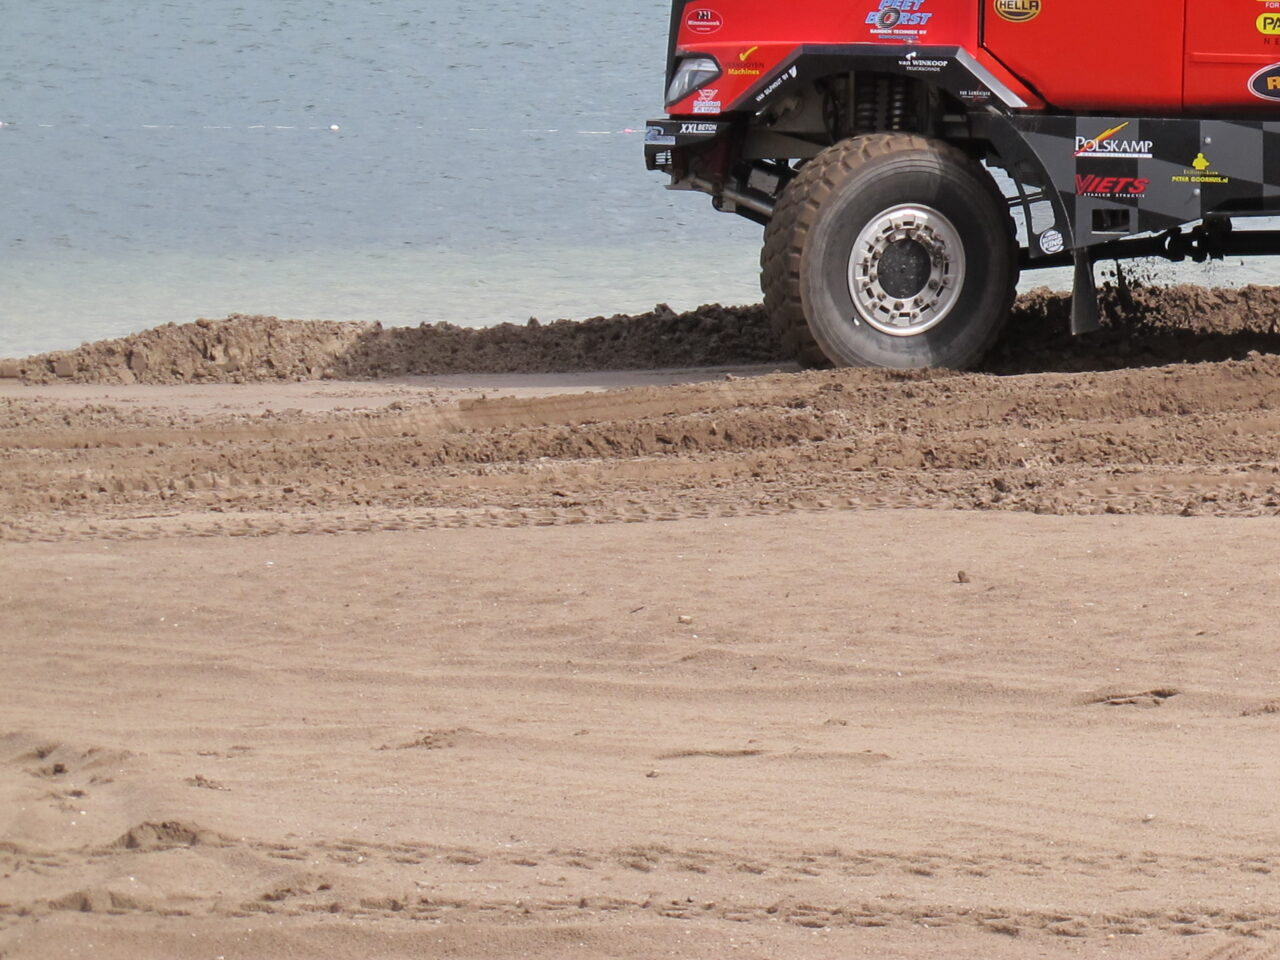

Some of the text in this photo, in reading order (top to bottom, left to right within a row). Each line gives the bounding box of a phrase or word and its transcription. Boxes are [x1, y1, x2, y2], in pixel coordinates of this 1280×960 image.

[1000, 0, 1039, 11] HELLA
[680, 123, 698, 133] XXL
[1075, 136, 1153, 153] POLSKAMP
[1076, 174, 1149, 195] VIETS
